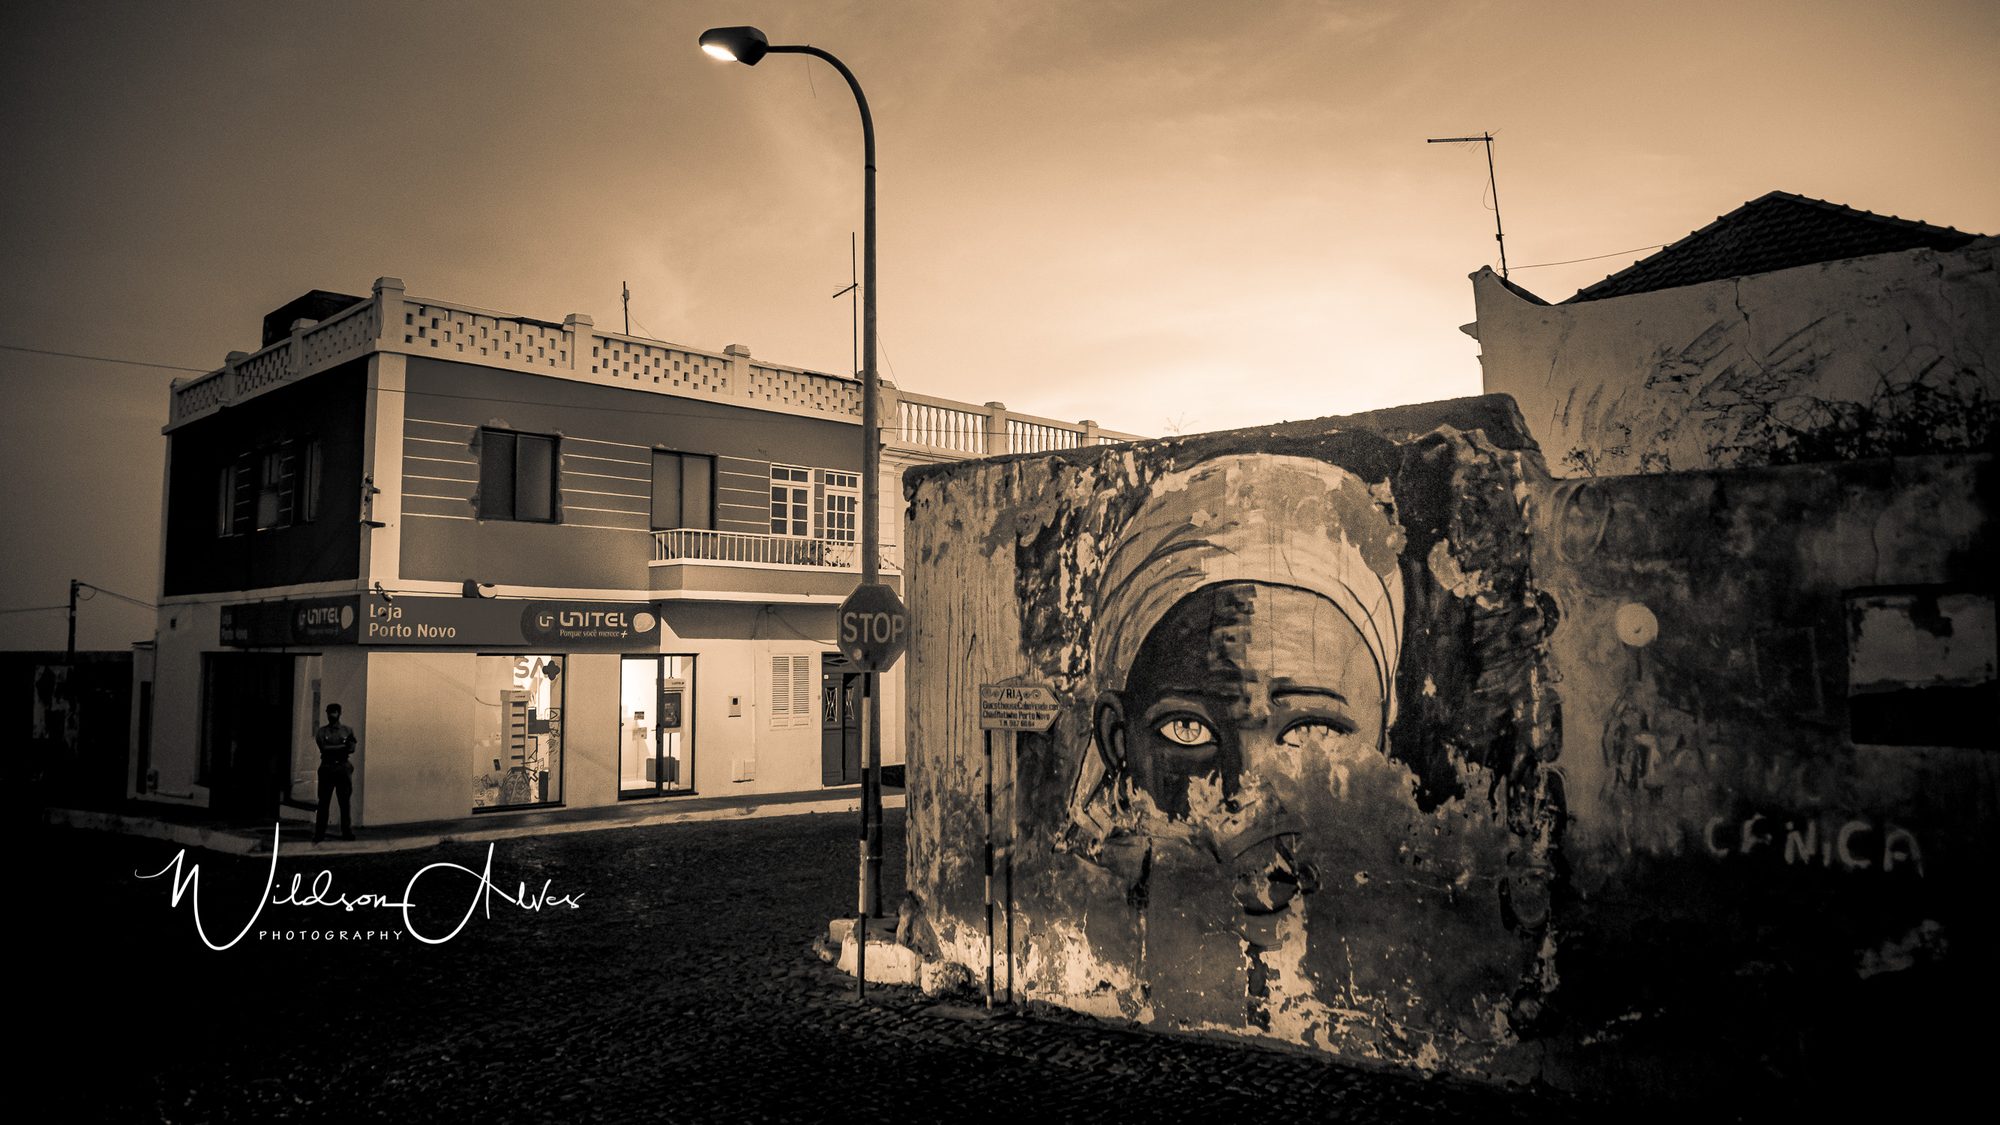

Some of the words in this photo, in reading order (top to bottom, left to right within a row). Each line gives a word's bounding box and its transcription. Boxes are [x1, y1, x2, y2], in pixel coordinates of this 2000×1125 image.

[307, 607, 339, 624] UNITEL
[370, 603, 402, 622] Loja
[559, 611, 628, 627] UNITEL
[369, 622, 412, 638] Porto
[417, 623, 457, 638] Novo
[559, 629, 582, 638] Porque
[843, 612, 905, 643] STOP
